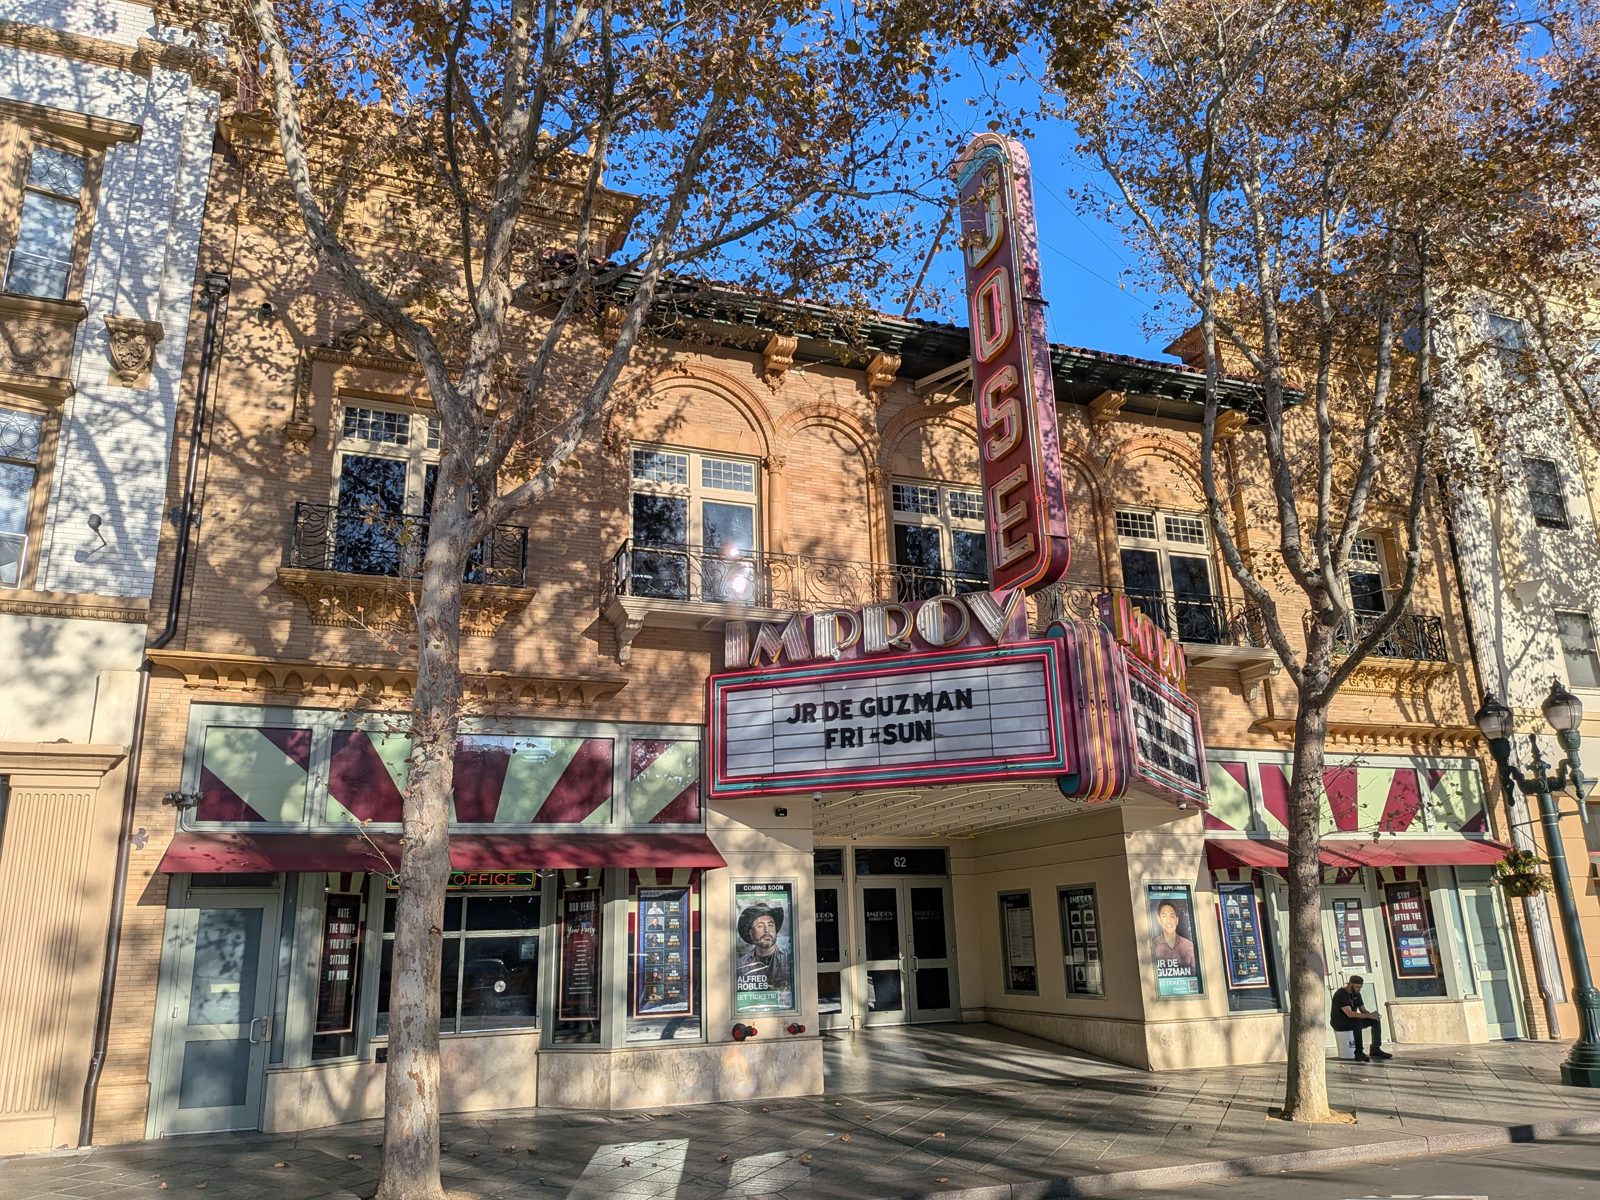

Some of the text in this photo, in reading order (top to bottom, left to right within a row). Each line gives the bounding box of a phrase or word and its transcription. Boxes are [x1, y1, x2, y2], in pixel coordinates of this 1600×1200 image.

[967, 168, 1036, 572] JOSE
[724, 586, 1025, 669] IMPROV
[787, 688, 973, 725] JR DE GUZMAN
[825, 726, 864, 749] FRI
[893, 856, 907, 868] 62
[453, 873, 518, 886] OFFICE
[1397, 891, 1410, 899] STAY
[1400, 901, 1419, 910] TOUCH
[337, 907, 350, 918] HATE
[1394, 912, 1422, 922] AFTER THE
[329, 923, 339, 934] THE
[1156, 959, 1179, 968] JR DE
[1157, 967, 1192, 977] GUZMAN
[737, 974, 768, 983] ALFRED
[737, 982, 769, 991] ROBLES
